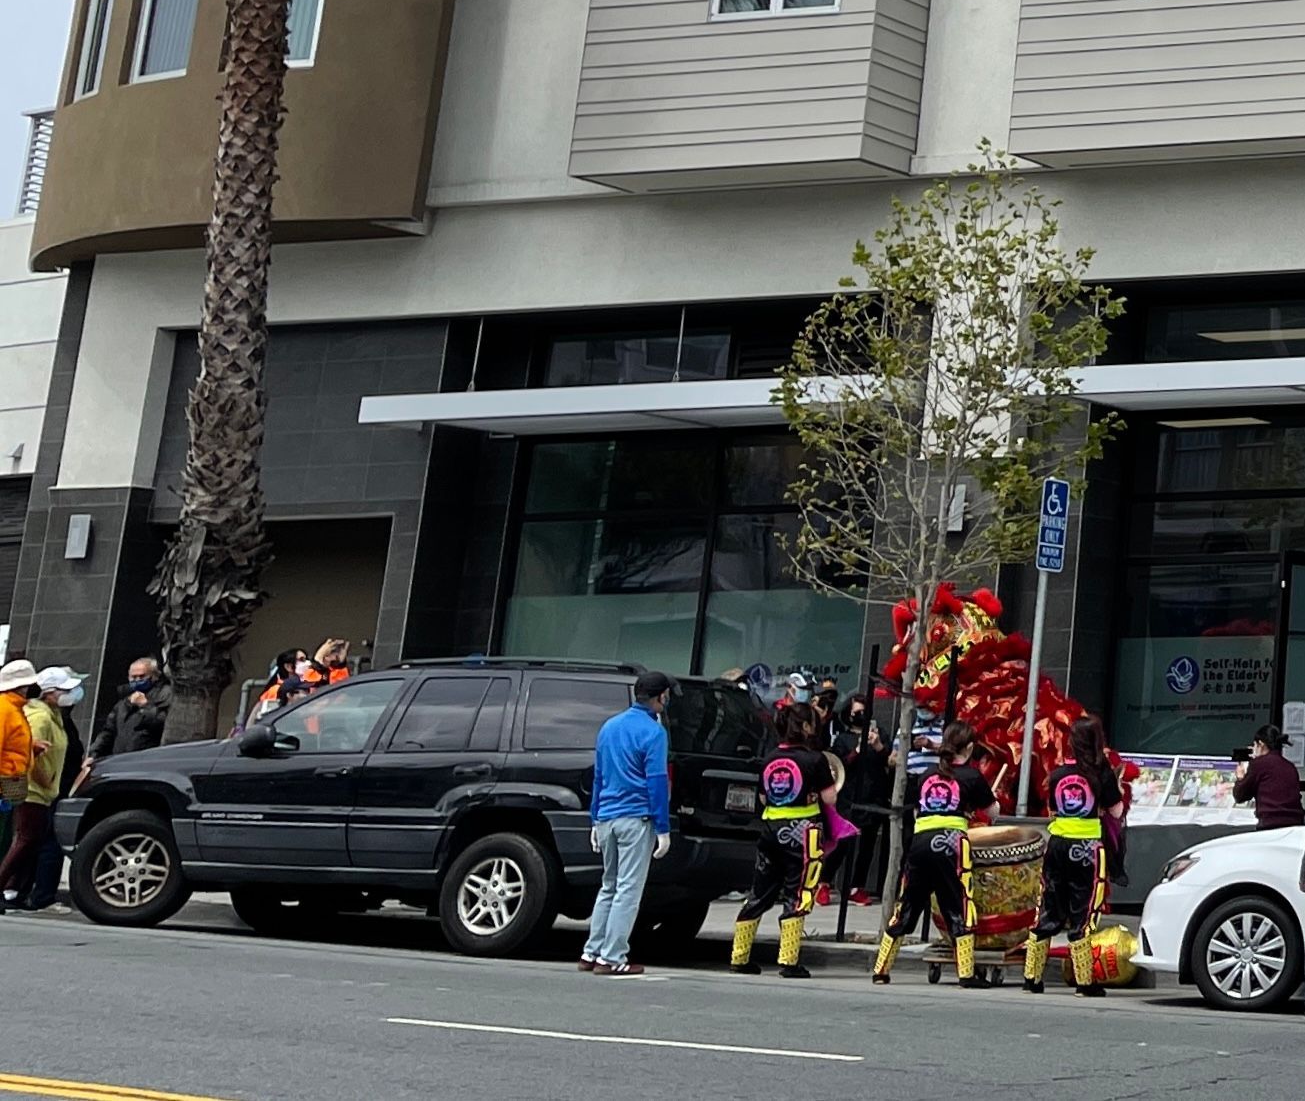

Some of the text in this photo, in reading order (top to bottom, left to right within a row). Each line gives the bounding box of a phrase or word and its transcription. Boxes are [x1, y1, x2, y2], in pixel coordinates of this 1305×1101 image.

[1044, 529, 1061, 544] ONLY
[832, 663, 851, 674] for
[1203, 669, 1270, 682] the Elderly
